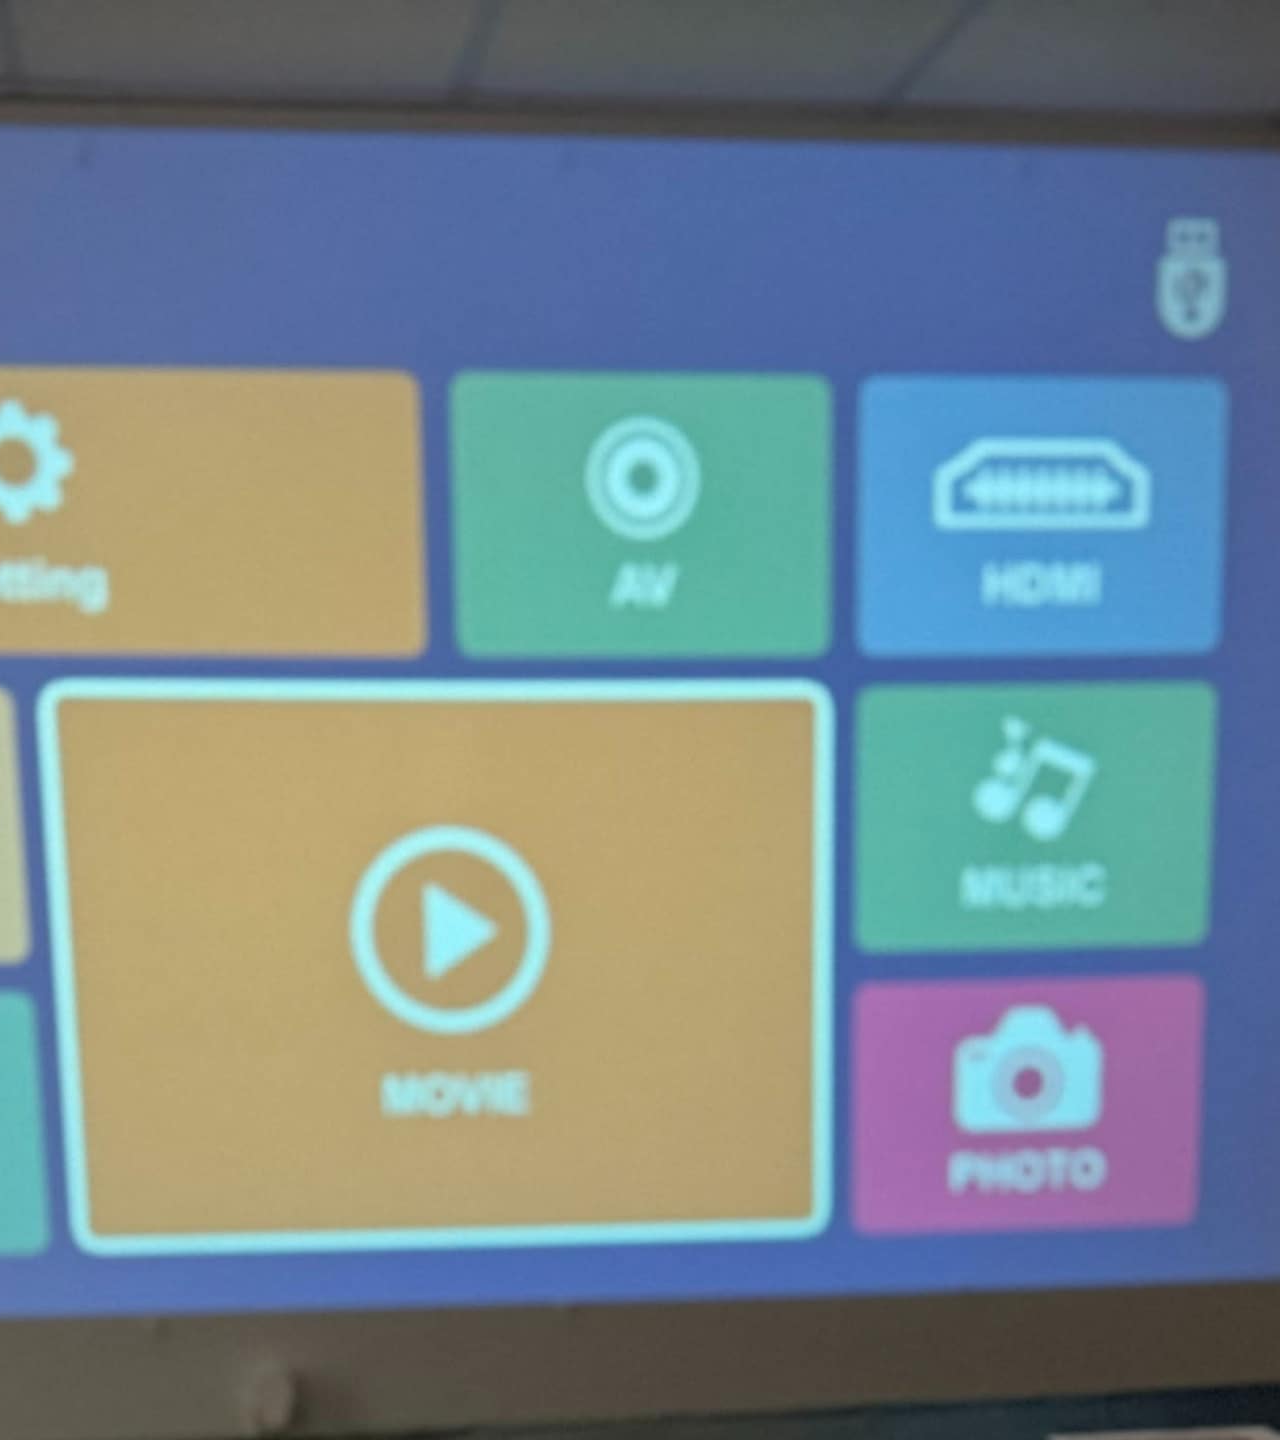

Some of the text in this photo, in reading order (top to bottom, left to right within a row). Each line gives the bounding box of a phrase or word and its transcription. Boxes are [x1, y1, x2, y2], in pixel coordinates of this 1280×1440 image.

[610, 562, 678, 608] AV
[980, 561, 1103, 606] HDMI
[960, 863, 1107, 909] MUSIC
[380, 1071, 530, 1116] MOVIE
[948, 1147, 1106, 1193] PHOTO
